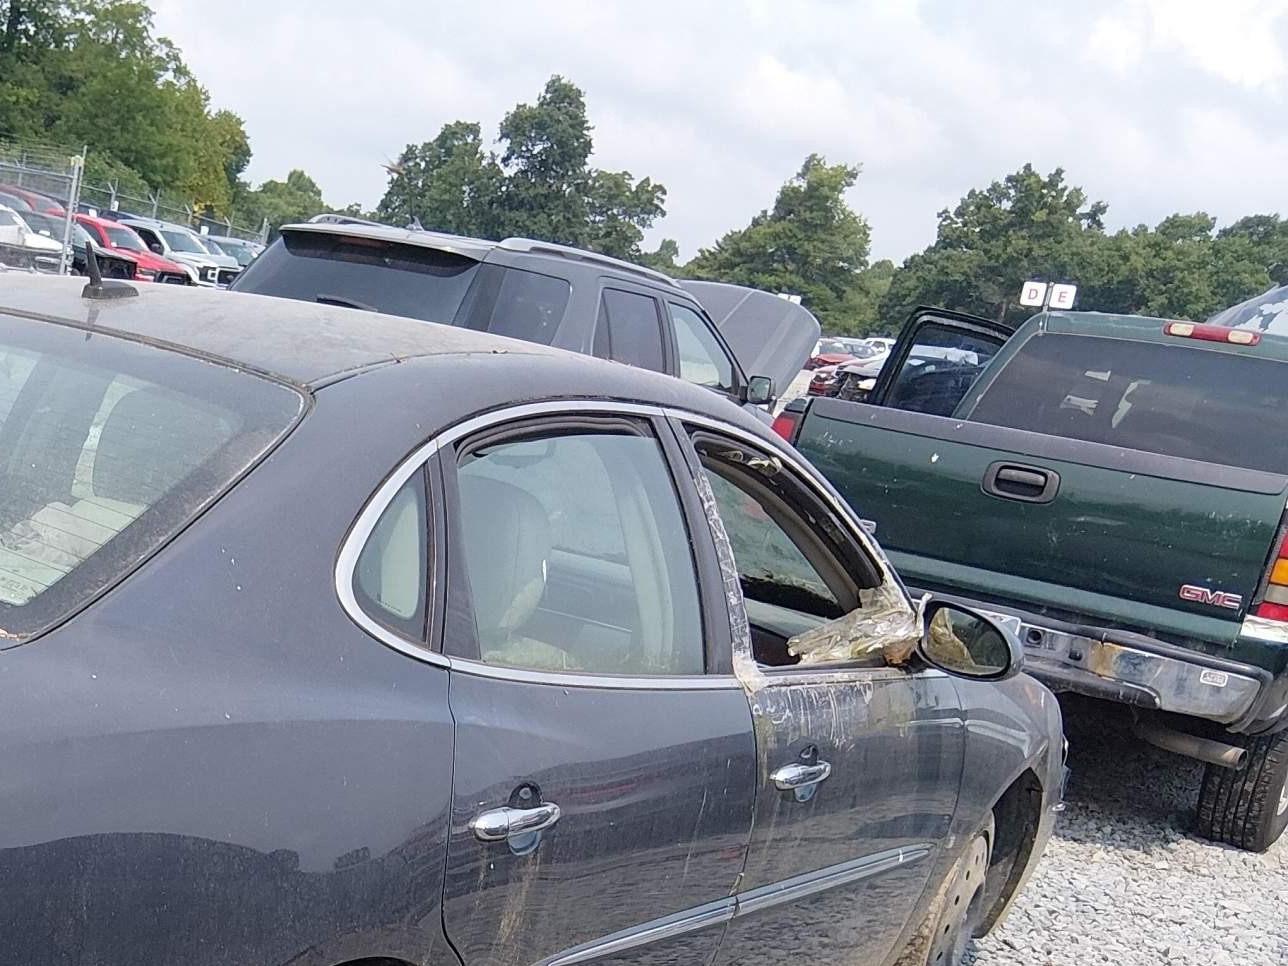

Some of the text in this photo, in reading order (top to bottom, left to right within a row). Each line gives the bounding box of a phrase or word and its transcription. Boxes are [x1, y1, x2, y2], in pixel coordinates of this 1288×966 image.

[1028, 288, 1039, 300] D
[1058, 291, 1068, 303] E
[1179, 584, 1243, 609] GMC
